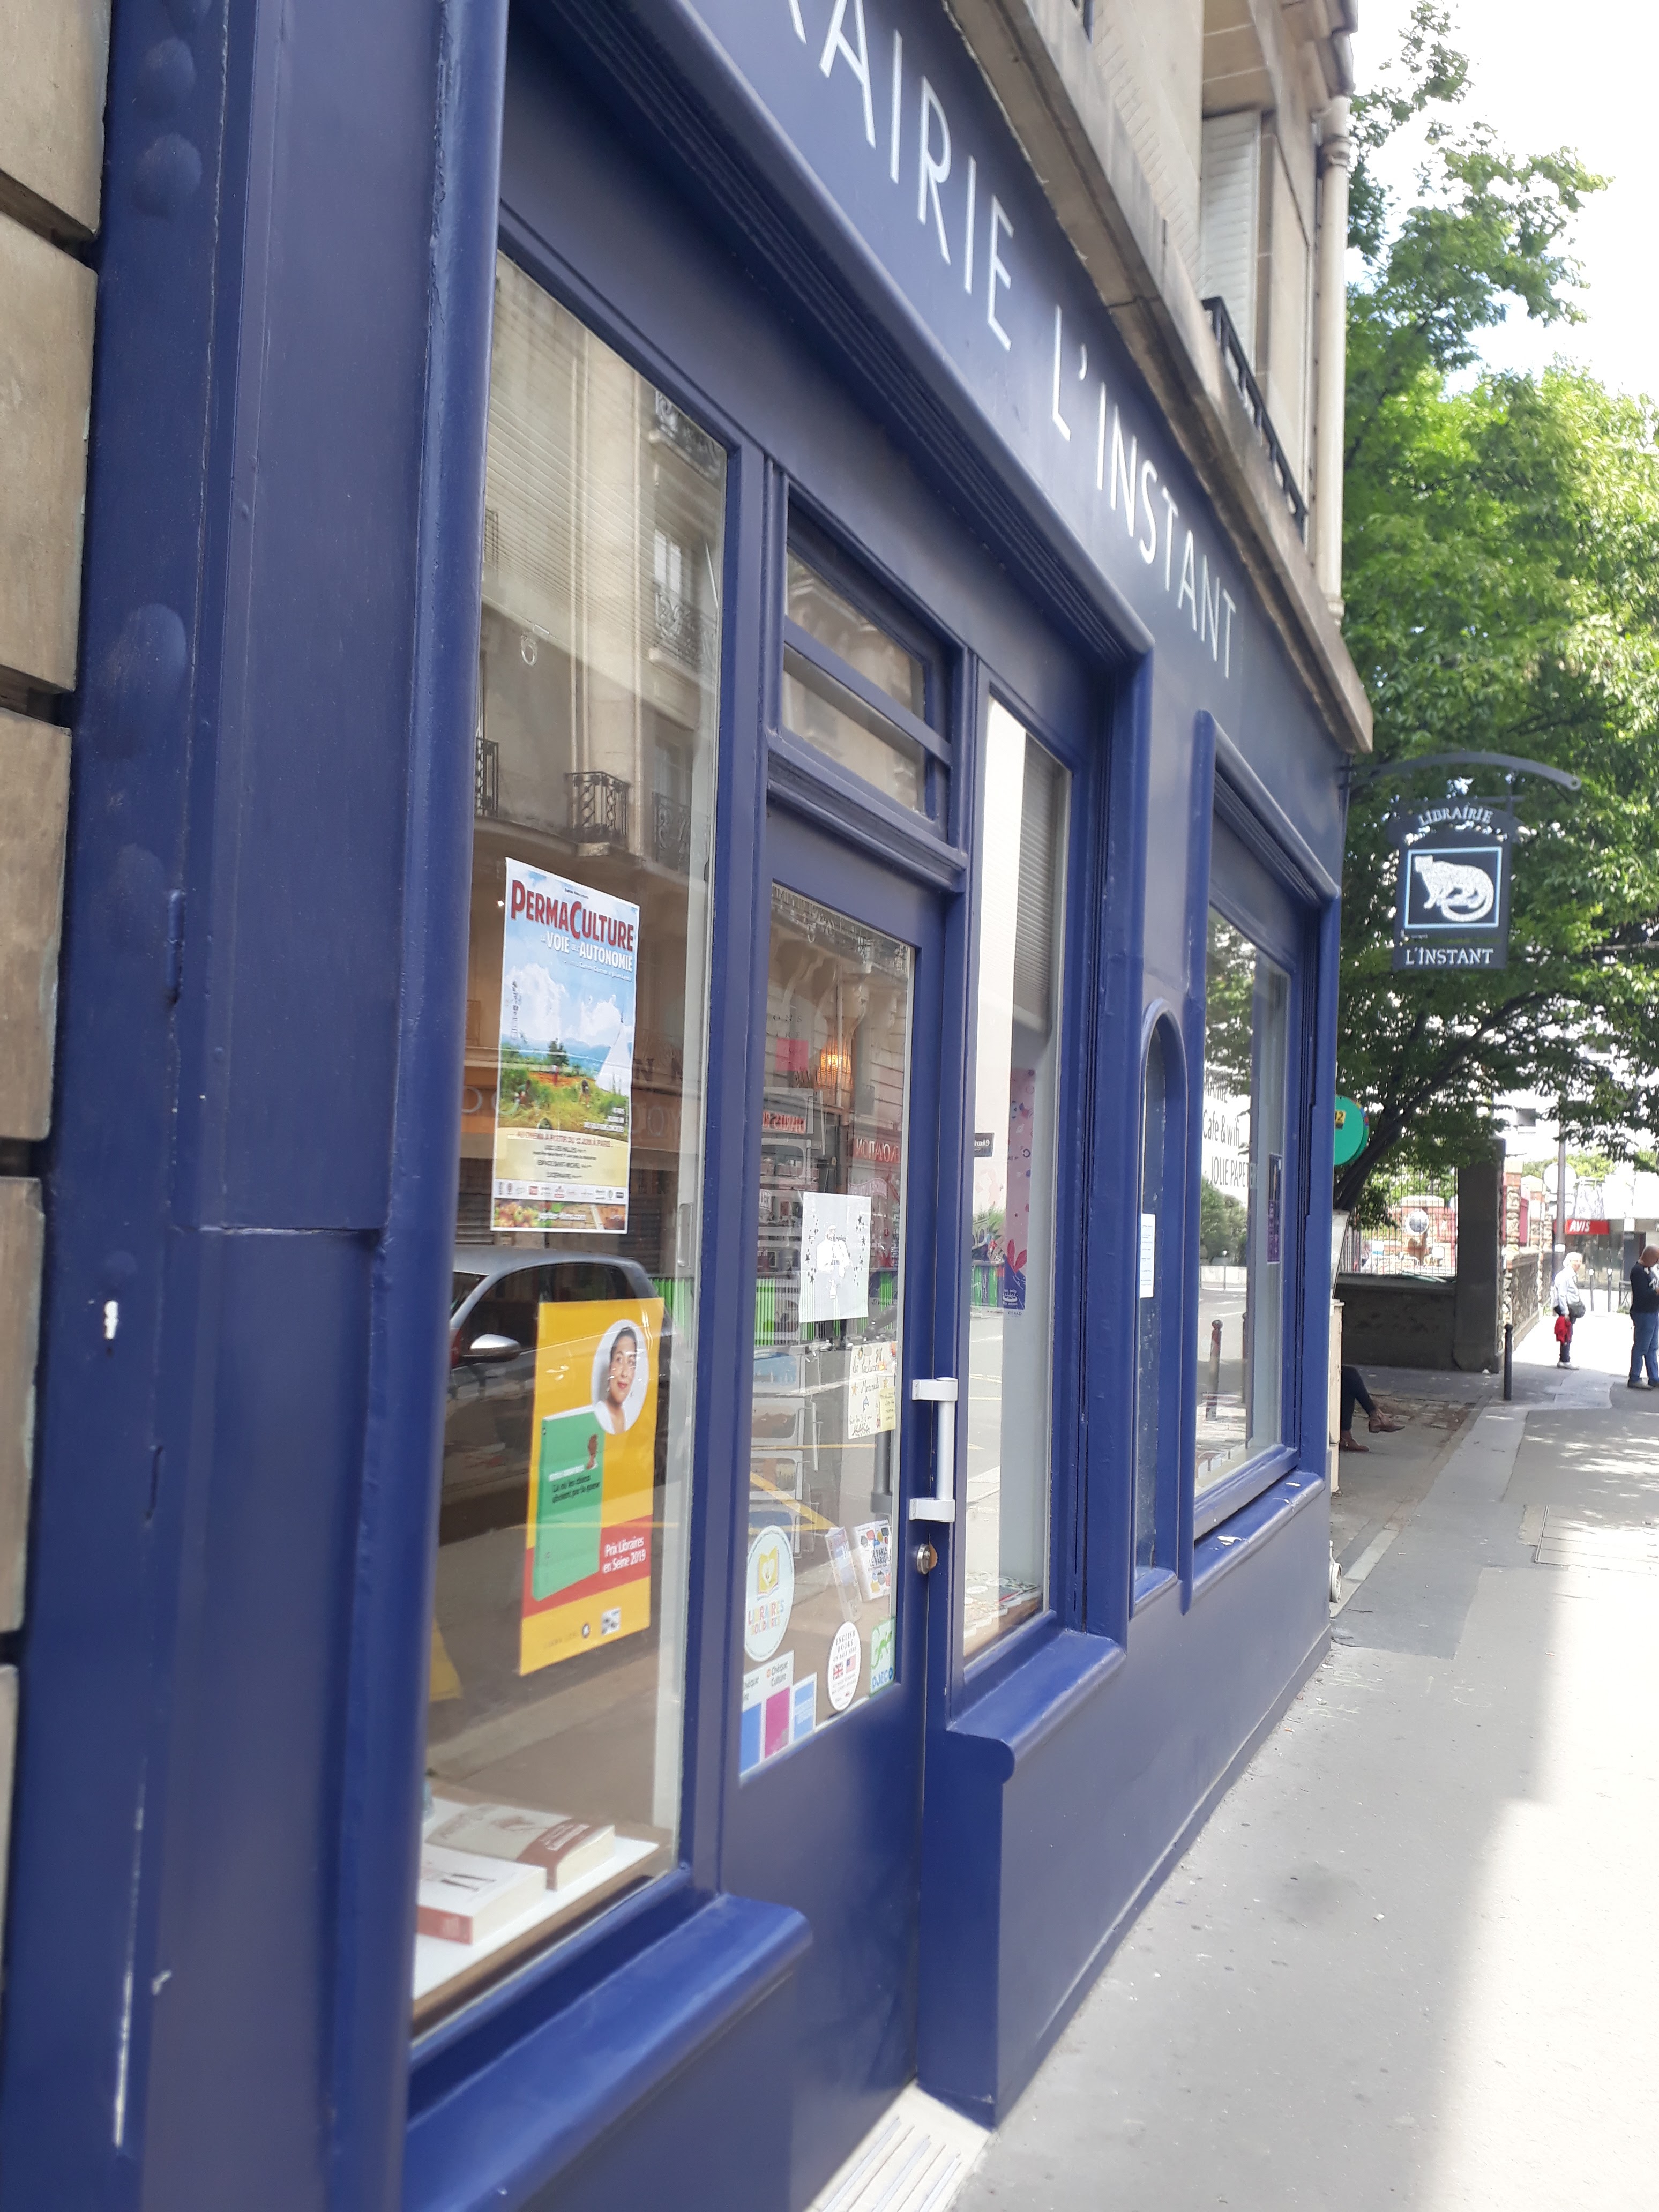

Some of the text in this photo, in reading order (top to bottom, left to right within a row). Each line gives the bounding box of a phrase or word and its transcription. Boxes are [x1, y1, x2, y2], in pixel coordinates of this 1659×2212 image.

[788, 0, 1236, 679] AIRIE L'INSTANT
[1418, 806, 1493, 826] LIBRAIRIE
[547, 931, 569, 954] VOIE
[1406, 946, 1494, 965] L'INSTANT
[1221, 1114, 1226, 1144] &
[1210, 1156, 1228, 1184] JOLIE
[1569, 1220, 1590, 1232] AVIS
[604, 1536, 644, 1558] Prix Libraires
[603, 1549, 646, 1574] en Seine 2019
[838, 1639, 853, 1653] BOOKS
[872, 1666, 893, 1689] DJECO
